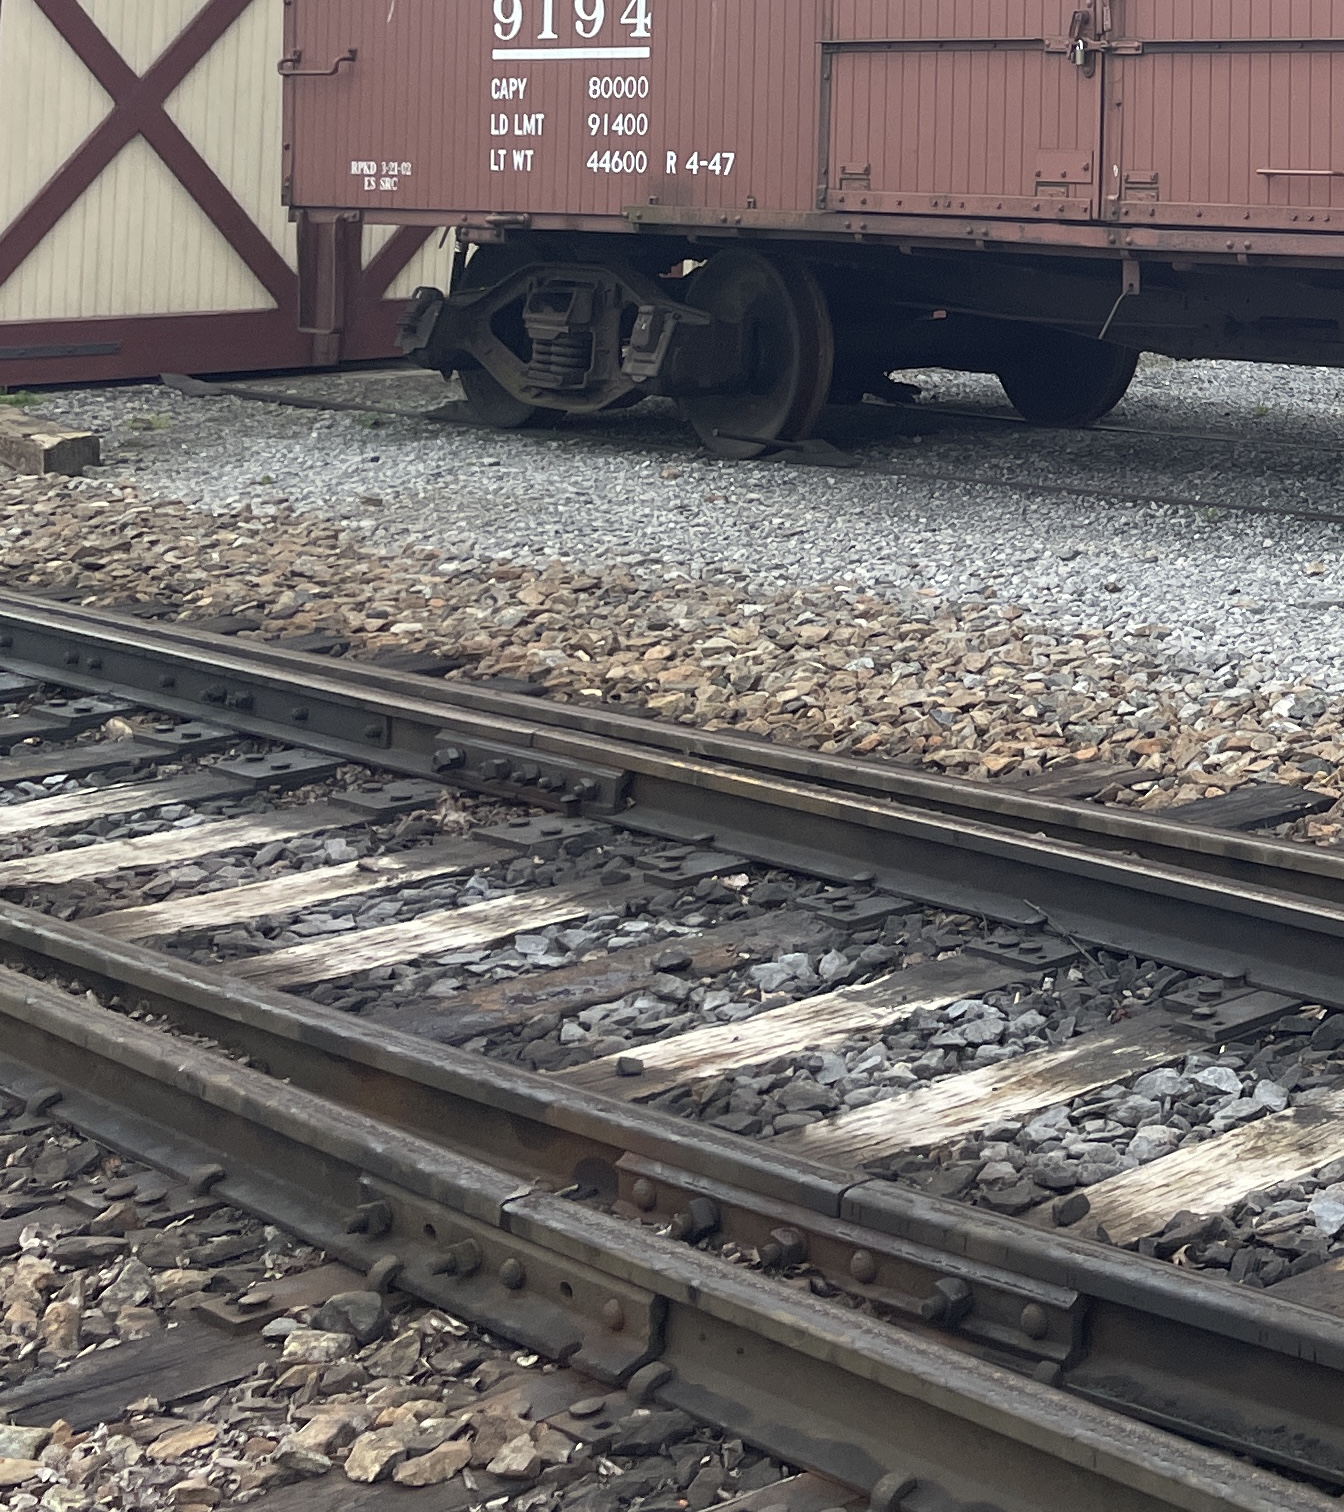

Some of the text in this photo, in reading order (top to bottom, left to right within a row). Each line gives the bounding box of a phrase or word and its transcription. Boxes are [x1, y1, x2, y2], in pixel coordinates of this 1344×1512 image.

[491, 75, 649, 100] CAPY 80000
[490, 113, 648, 136] LD LMT 91400
[350, 160, 377, 175] RPKD
[490, 148, 735, 176] LT WT 44600 R 4-47
[379, 176, 399, 191] SRC
